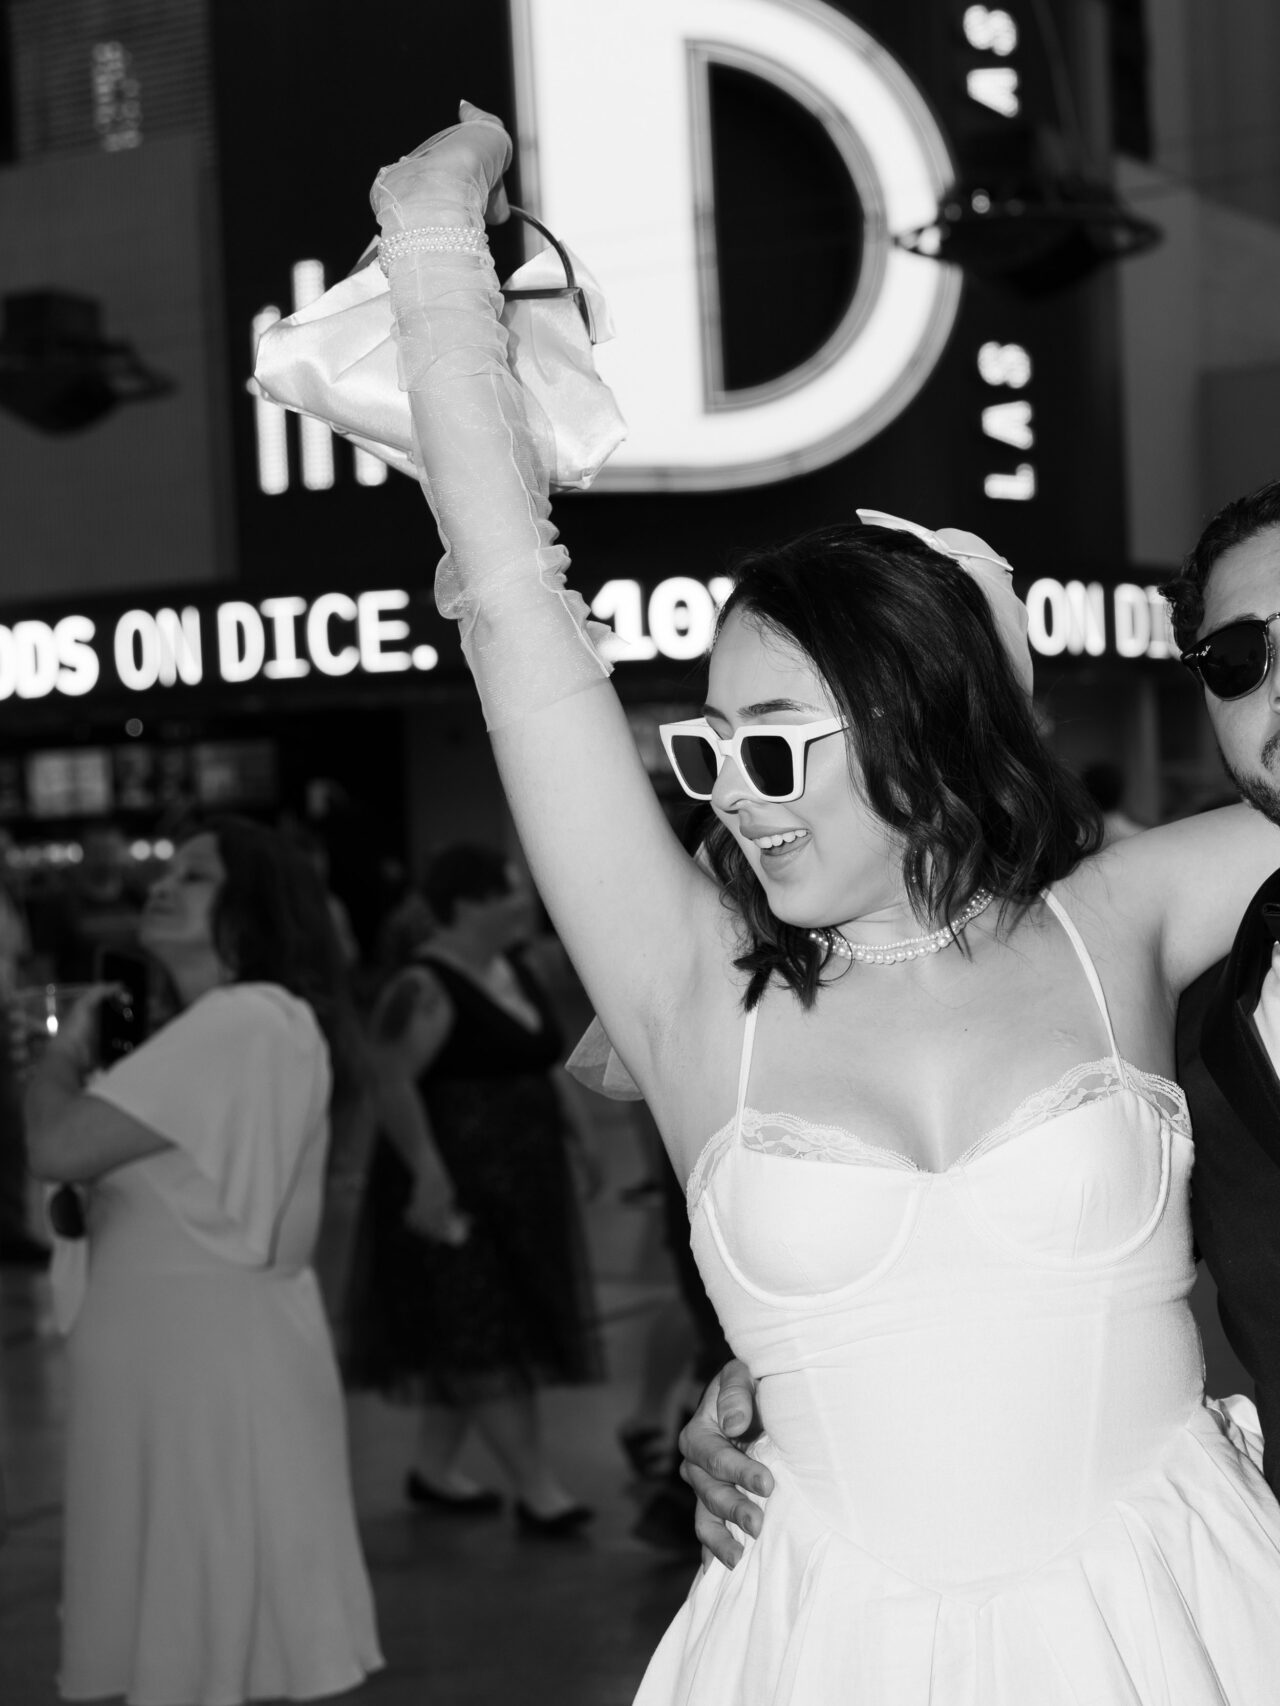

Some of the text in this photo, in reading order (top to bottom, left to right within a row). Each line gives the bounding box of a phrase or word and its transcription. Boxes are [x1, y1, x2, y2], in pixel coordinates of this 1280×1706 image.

[510, 0, 963, 492] D
[963, 4, 1035, 500] LAS AS
[114, 605, 203, 691] ON
[217, 589, 438, 682] DICE.
[591, 576, 737, 661] 10
[1026, 577, 1106, 656] ON
